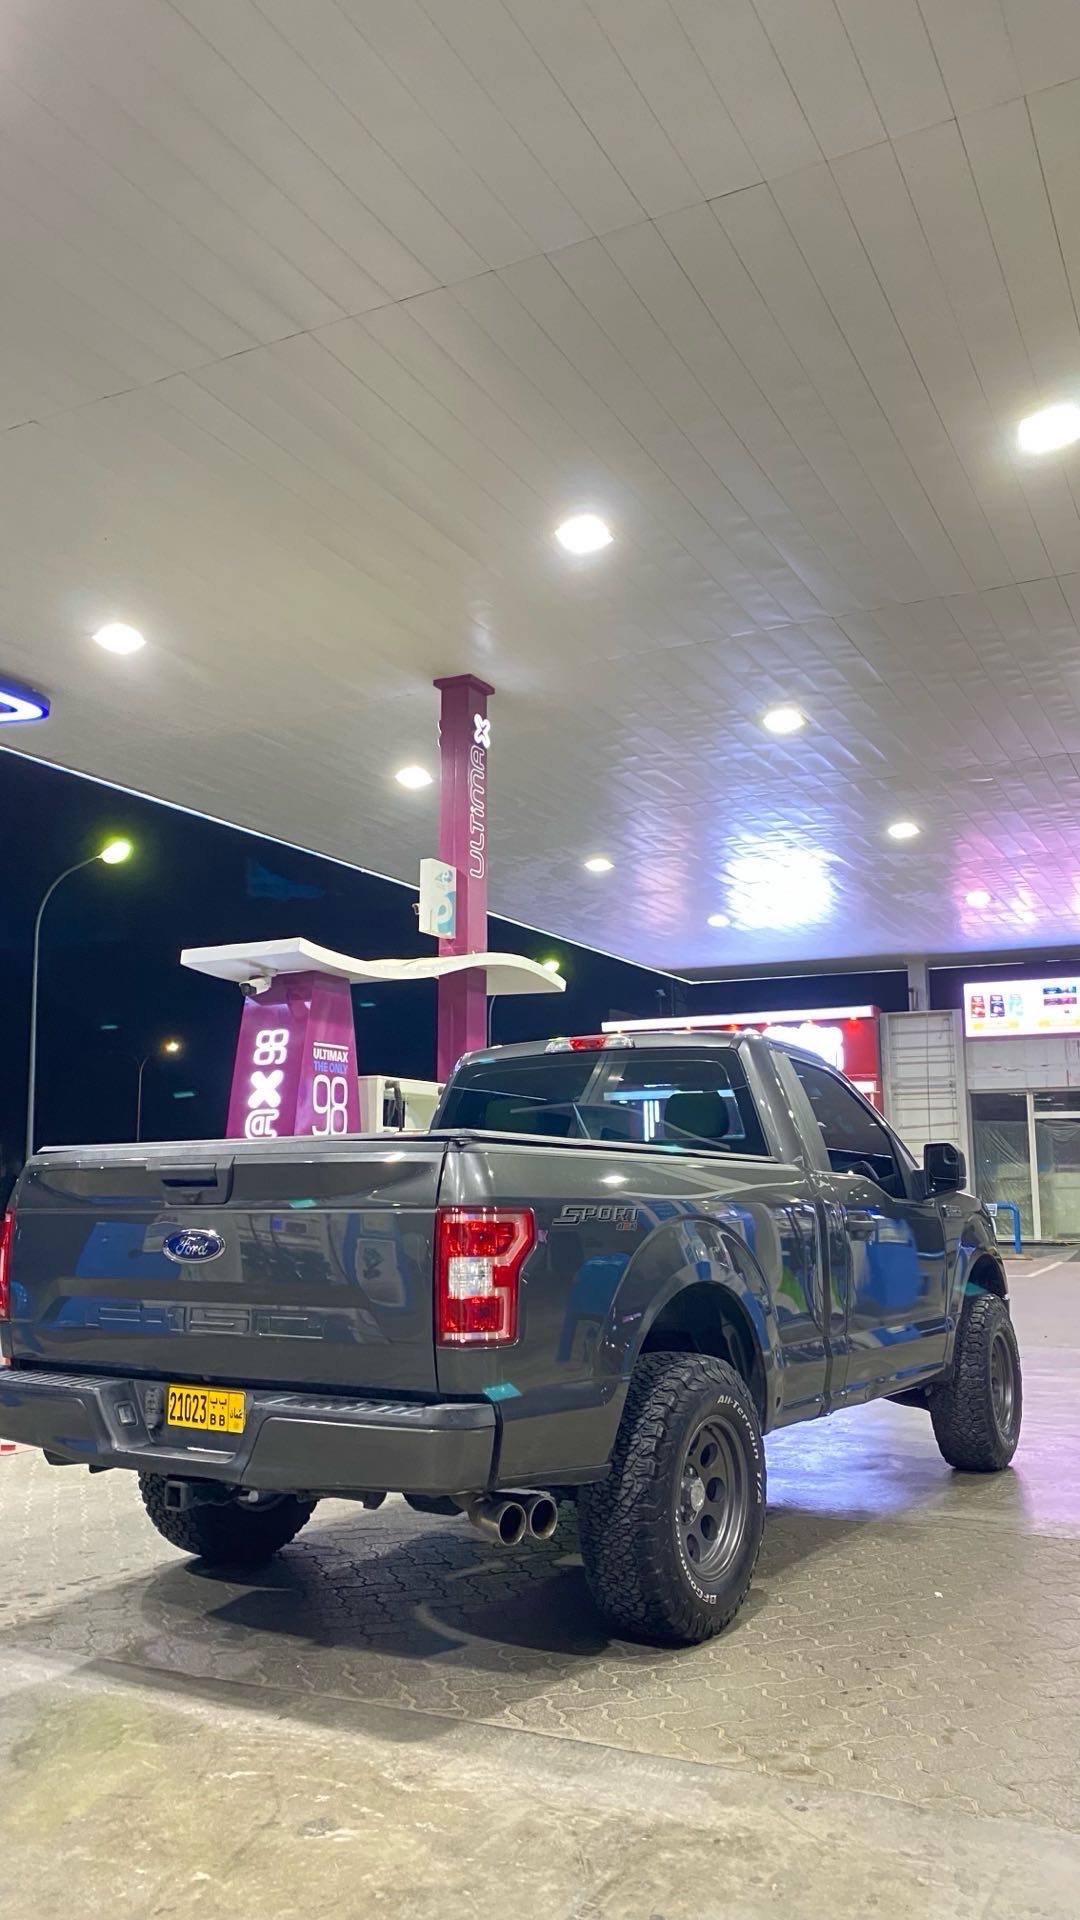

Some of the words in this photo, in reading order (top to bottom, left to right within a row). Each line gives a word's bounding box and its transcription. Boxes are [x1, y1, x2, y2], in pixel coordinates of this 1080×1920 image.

[313, 1047, 348, 1063] ULTIMAX
[313, 1060, 328, 1072] THE
[329, 1062, 348, 1074] ONLY
[312, 1074, 348, 1136] 98
[552, 1204, 644, 1226] SPORT
[175, 1236, 209, 1256] Ford
[169, 1392, 207, 1424] 21023
[717, 1394, 759, 1460] All-Terrain
